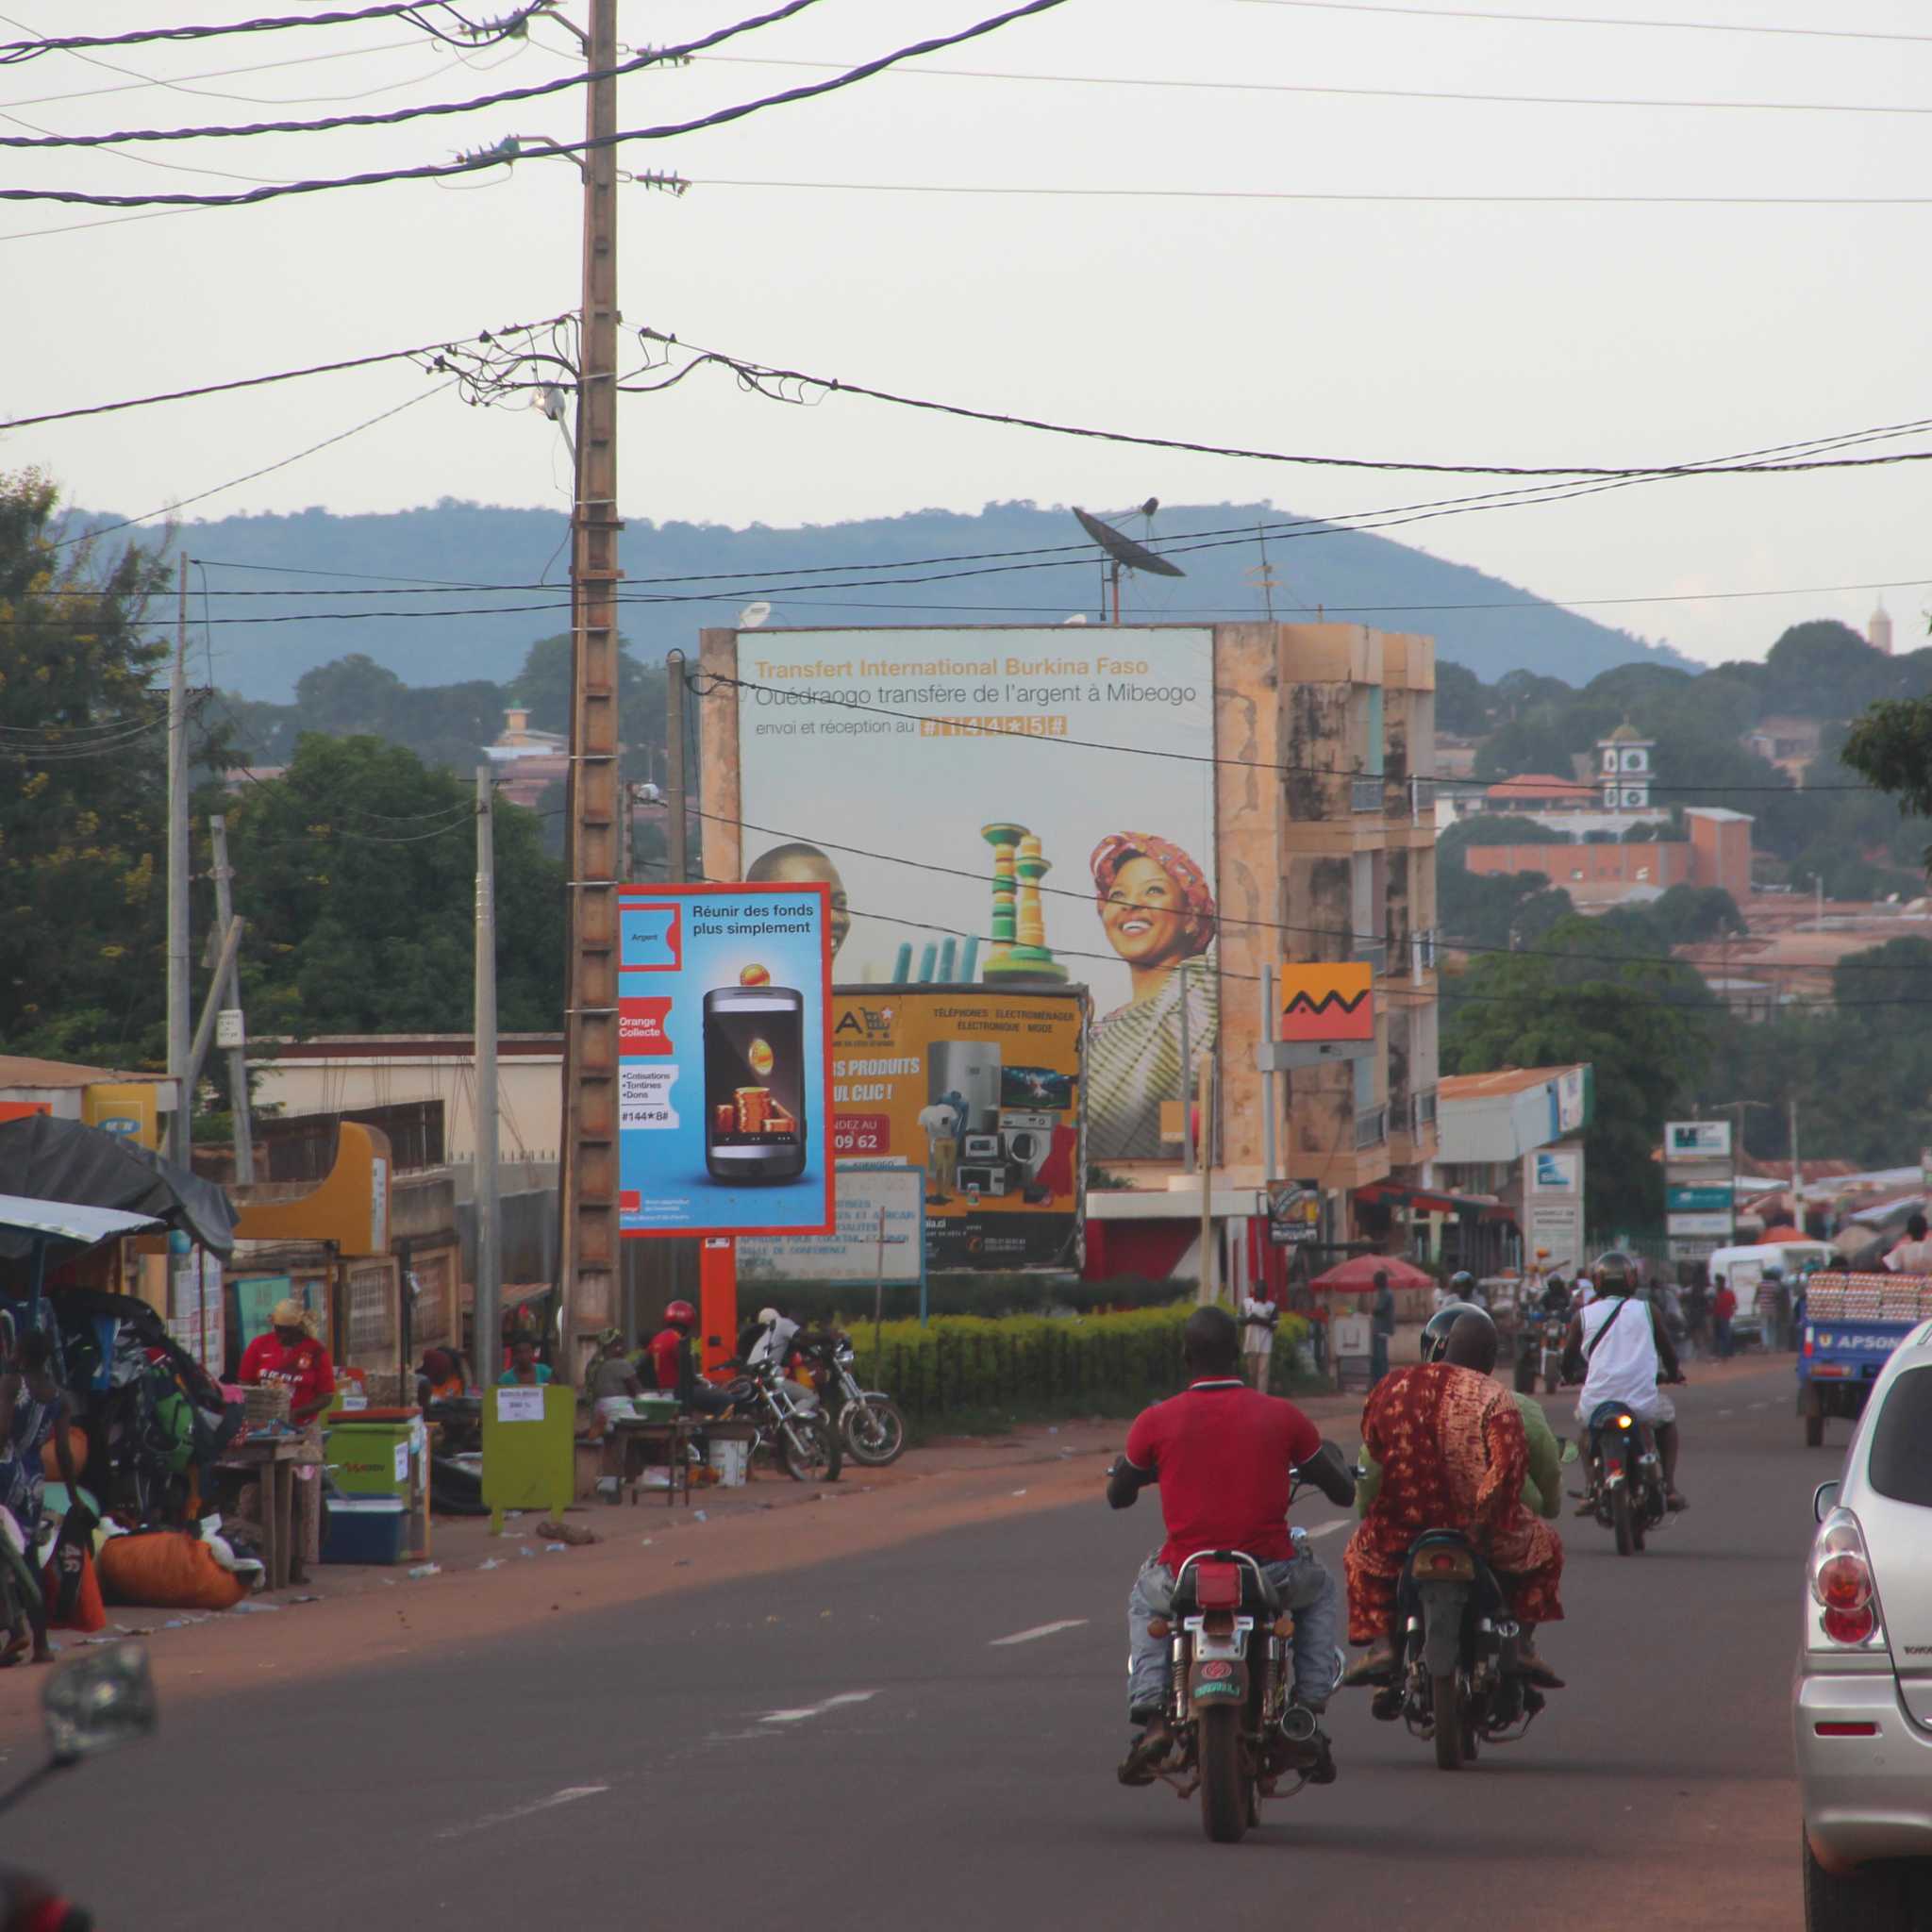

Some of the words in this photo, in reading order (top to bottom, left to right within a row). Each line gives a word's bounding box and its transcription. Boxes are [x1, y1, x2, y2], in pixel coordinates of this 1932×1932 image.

[757, 660, 852, 678] Transfert
[860, 658, 997, 676] International
[1006, 658, 1089, 675] Burkina
[1097, 658, 1148, 674] Faso
[756, 686, 871, 708] Ouédraogo
[878, 685, 966, 703] transfère
[974, 684, 998, 702] de
[1006, 684, 1081, 706] l'argent
[1089, 683, 1100, 701] à
[1108, 682, 1196, 706] Mibeogo
[757, 720, 796, 735] envoi
[801, 722, 814, 734] et
[821, 719, 891, 736] réception
[896, 721, 914, 733] au
[692, 905, 741, 917] Réunir
[744, 906, 769, 916] des
[774, 904, 813, 916] fonds
[693, 922, 723, 936] plus
[727, 922, 810, 936] simplement
[619, 1017, 656, 1027] Orange
[619, 1027, 660, 1038] Collecte
[848, 1057, 920, 1076] PRODUITS
[626, 1091, 649, 1099] Dons
[852, 1084, 885, 1102] CLIC
[835, 1135, 853, 1149] 09
[858, 1134, 877, 1148] 62
